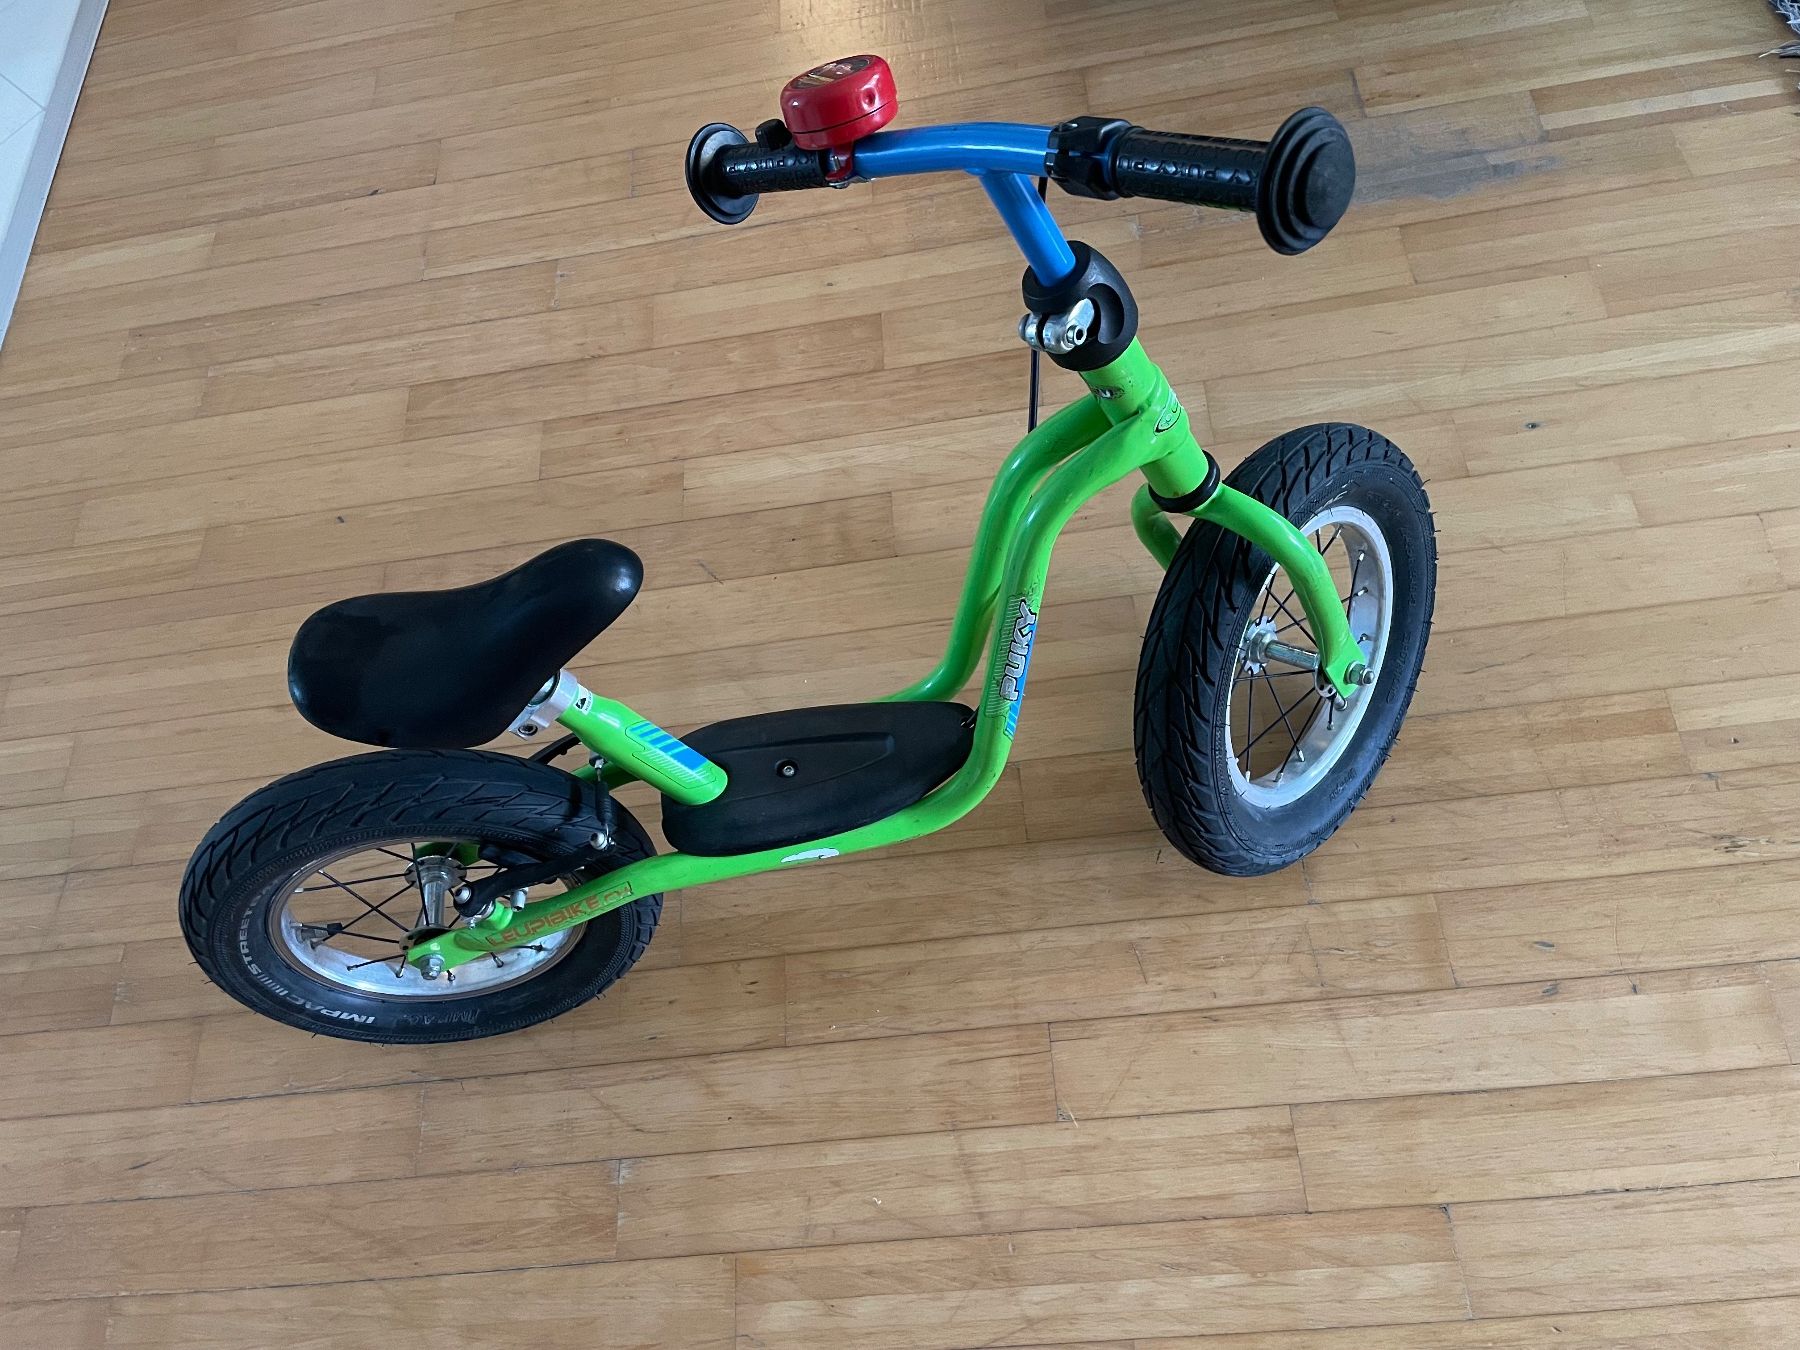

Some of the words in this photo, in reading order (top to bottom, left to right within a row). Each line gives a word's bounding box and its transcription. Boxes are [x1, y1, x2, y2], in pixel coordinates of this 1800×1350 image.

[1154, 158, 1218, 181] PUKY
[999, 599, 1036, 701] PUKY
[286, 993, 376, 1024] IMPAC
